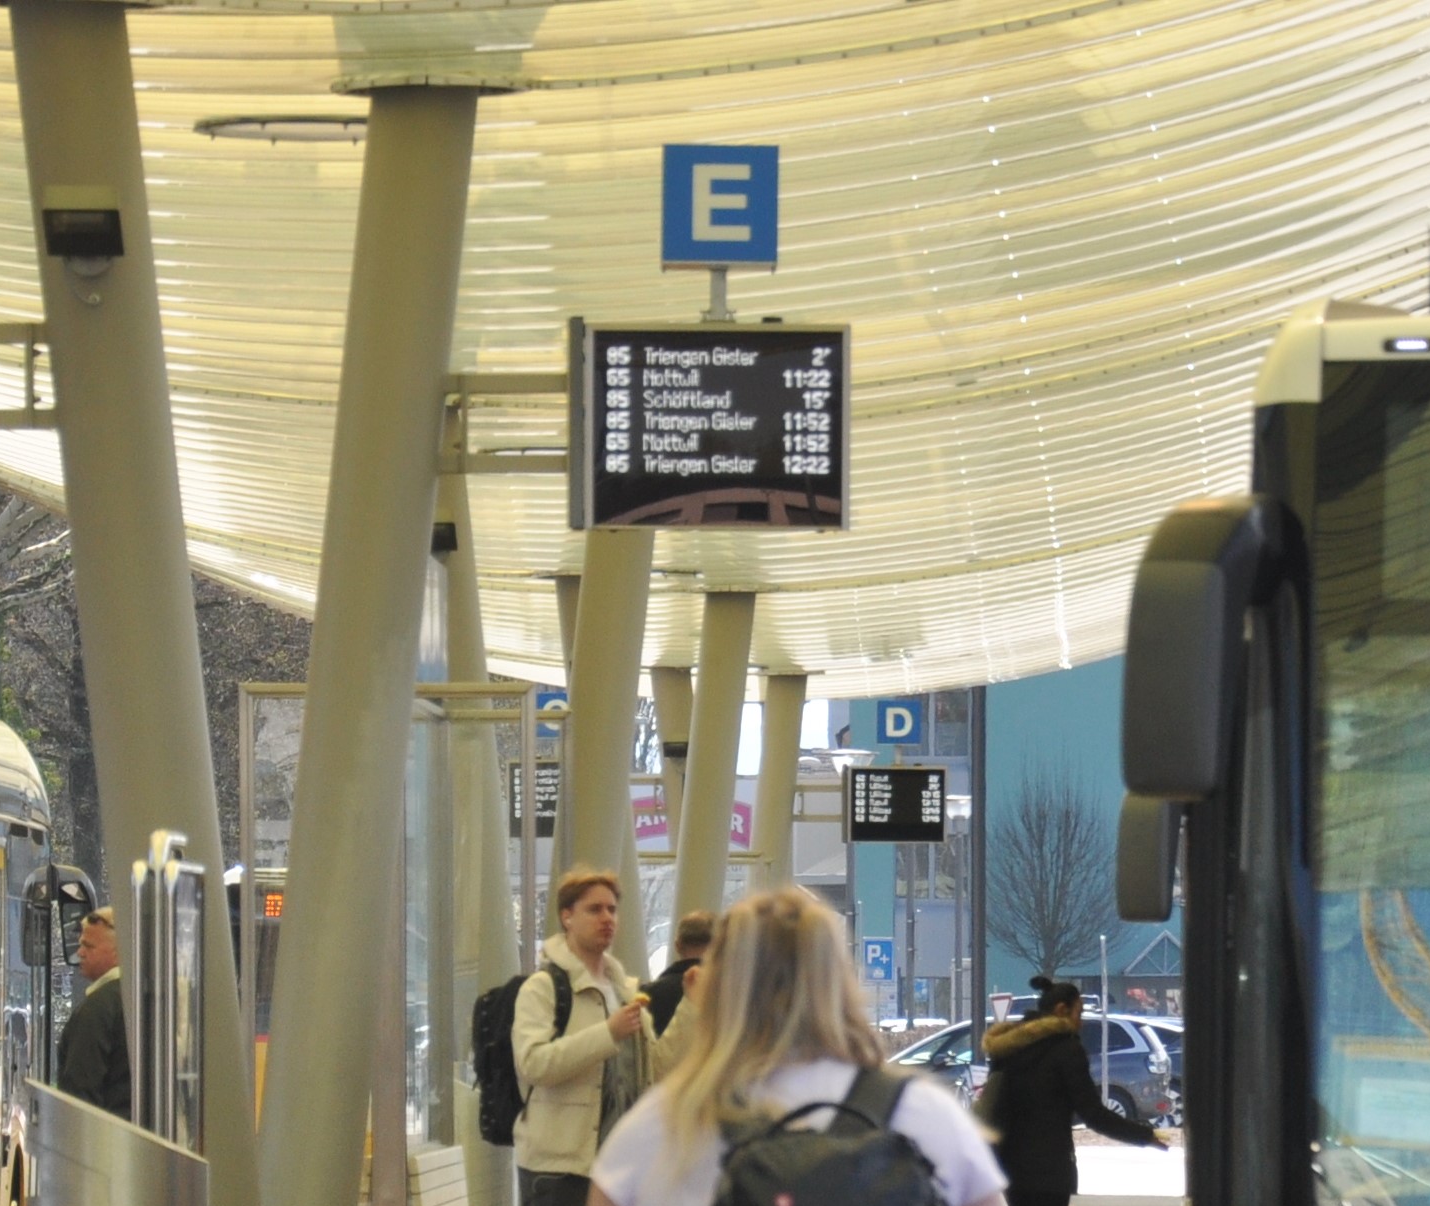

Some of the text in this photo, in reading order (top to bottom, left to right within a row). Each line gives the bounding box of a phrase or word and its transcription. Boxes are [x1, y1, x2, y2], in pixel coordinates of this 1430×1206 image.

[692, 163, 751, 242] E
[606, 346, 631, 366] 85
[643, 346, 710, 367] Triengen
[606, 368, 832, 388] 65 Nottwil 11:22
[606, 390, 631, 409] 85
[642, 389, 732, 409] Schöftland
[605, 411, 631, 430] 85
[643, 411, 709, 432] Triengen
[782, 412, 831, 431] 11:52
[605, 432, 831, 453] 65 Nottwil 11:52
[605, 454, 630, 474] 85
[643, 454, 709, 476] Triengen
[782, 455, 831, 475] 12:22
[885, 706, 913, 738] D
